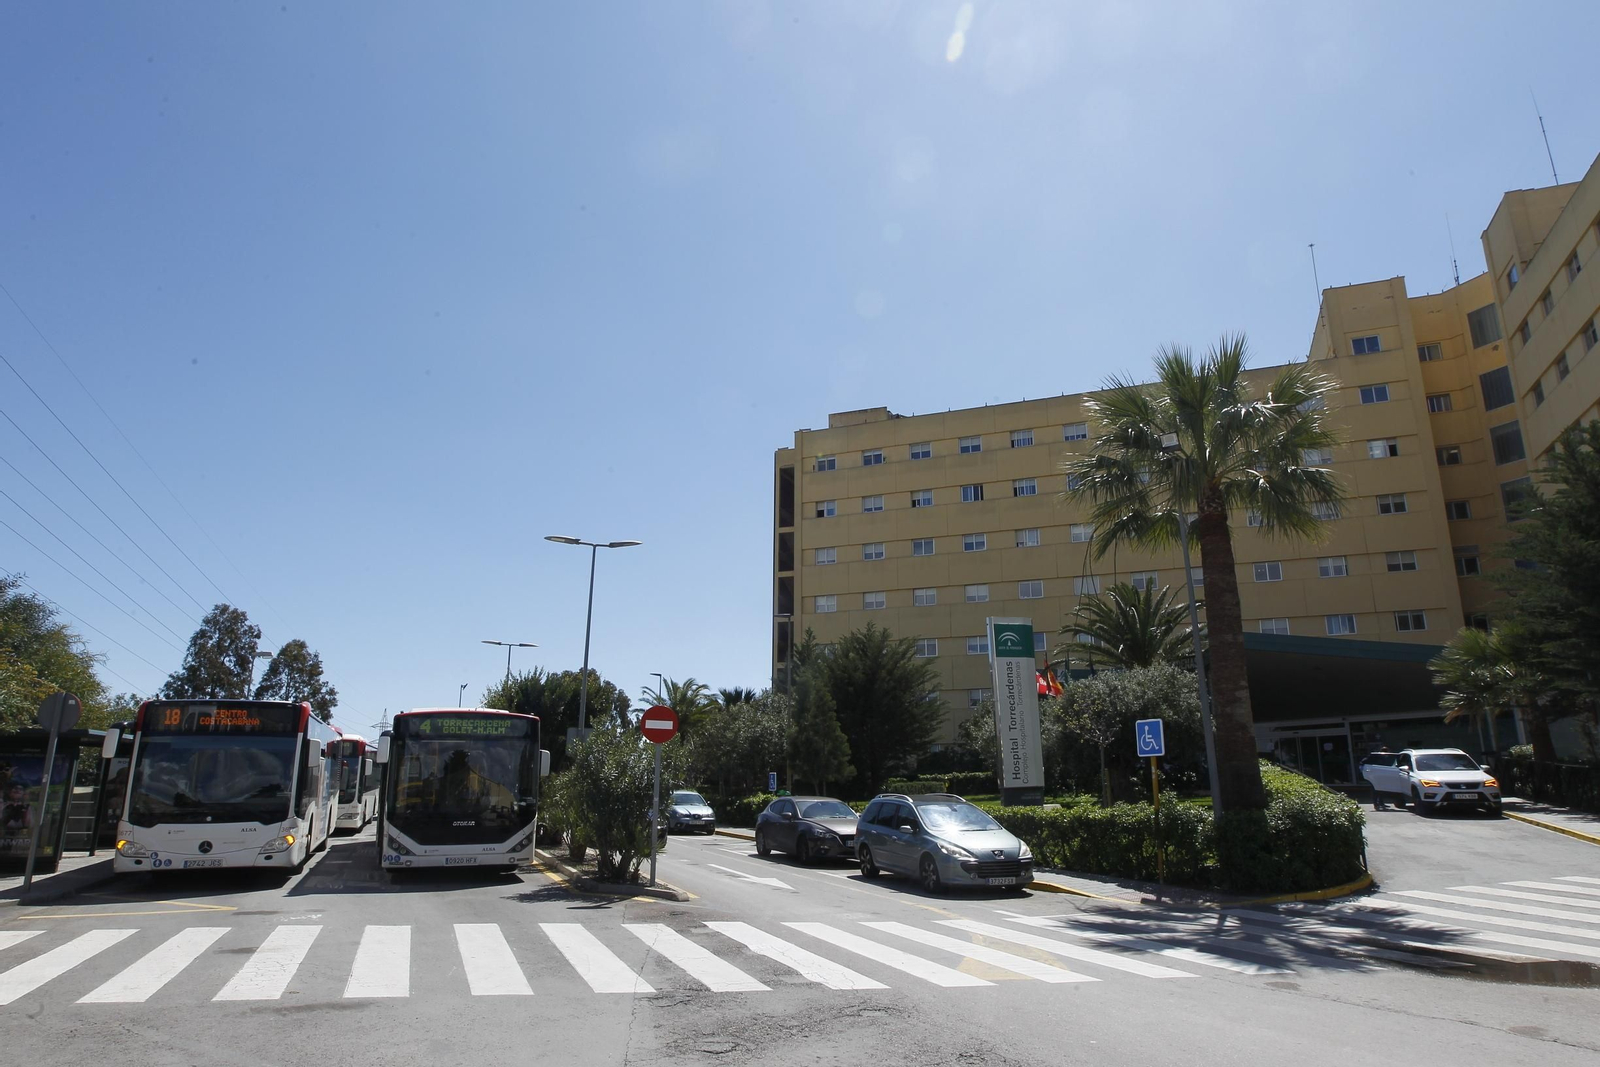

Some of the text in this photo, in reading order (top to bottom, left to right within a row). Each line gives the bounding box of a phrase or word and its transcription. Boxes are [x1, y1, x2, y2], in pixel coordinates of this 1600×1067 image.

[1005, 661, 1017, 732] Torrecárdenas
[164, 708, 181, 725] 18
[199, 717, 261, 726] COSTACABANA
[214, 709, 248, 718] CENTRO
[419, 719, 431, 734] 4
[437, 719, 511, 727] TORRECARDENA
[1017, 710, 1027, 750] Hospitalario
[1009, 738, 1021, 780] Hospital
[1021, 752, 1029, 784] Complejo
[188, 860, 206, 868] 2742
